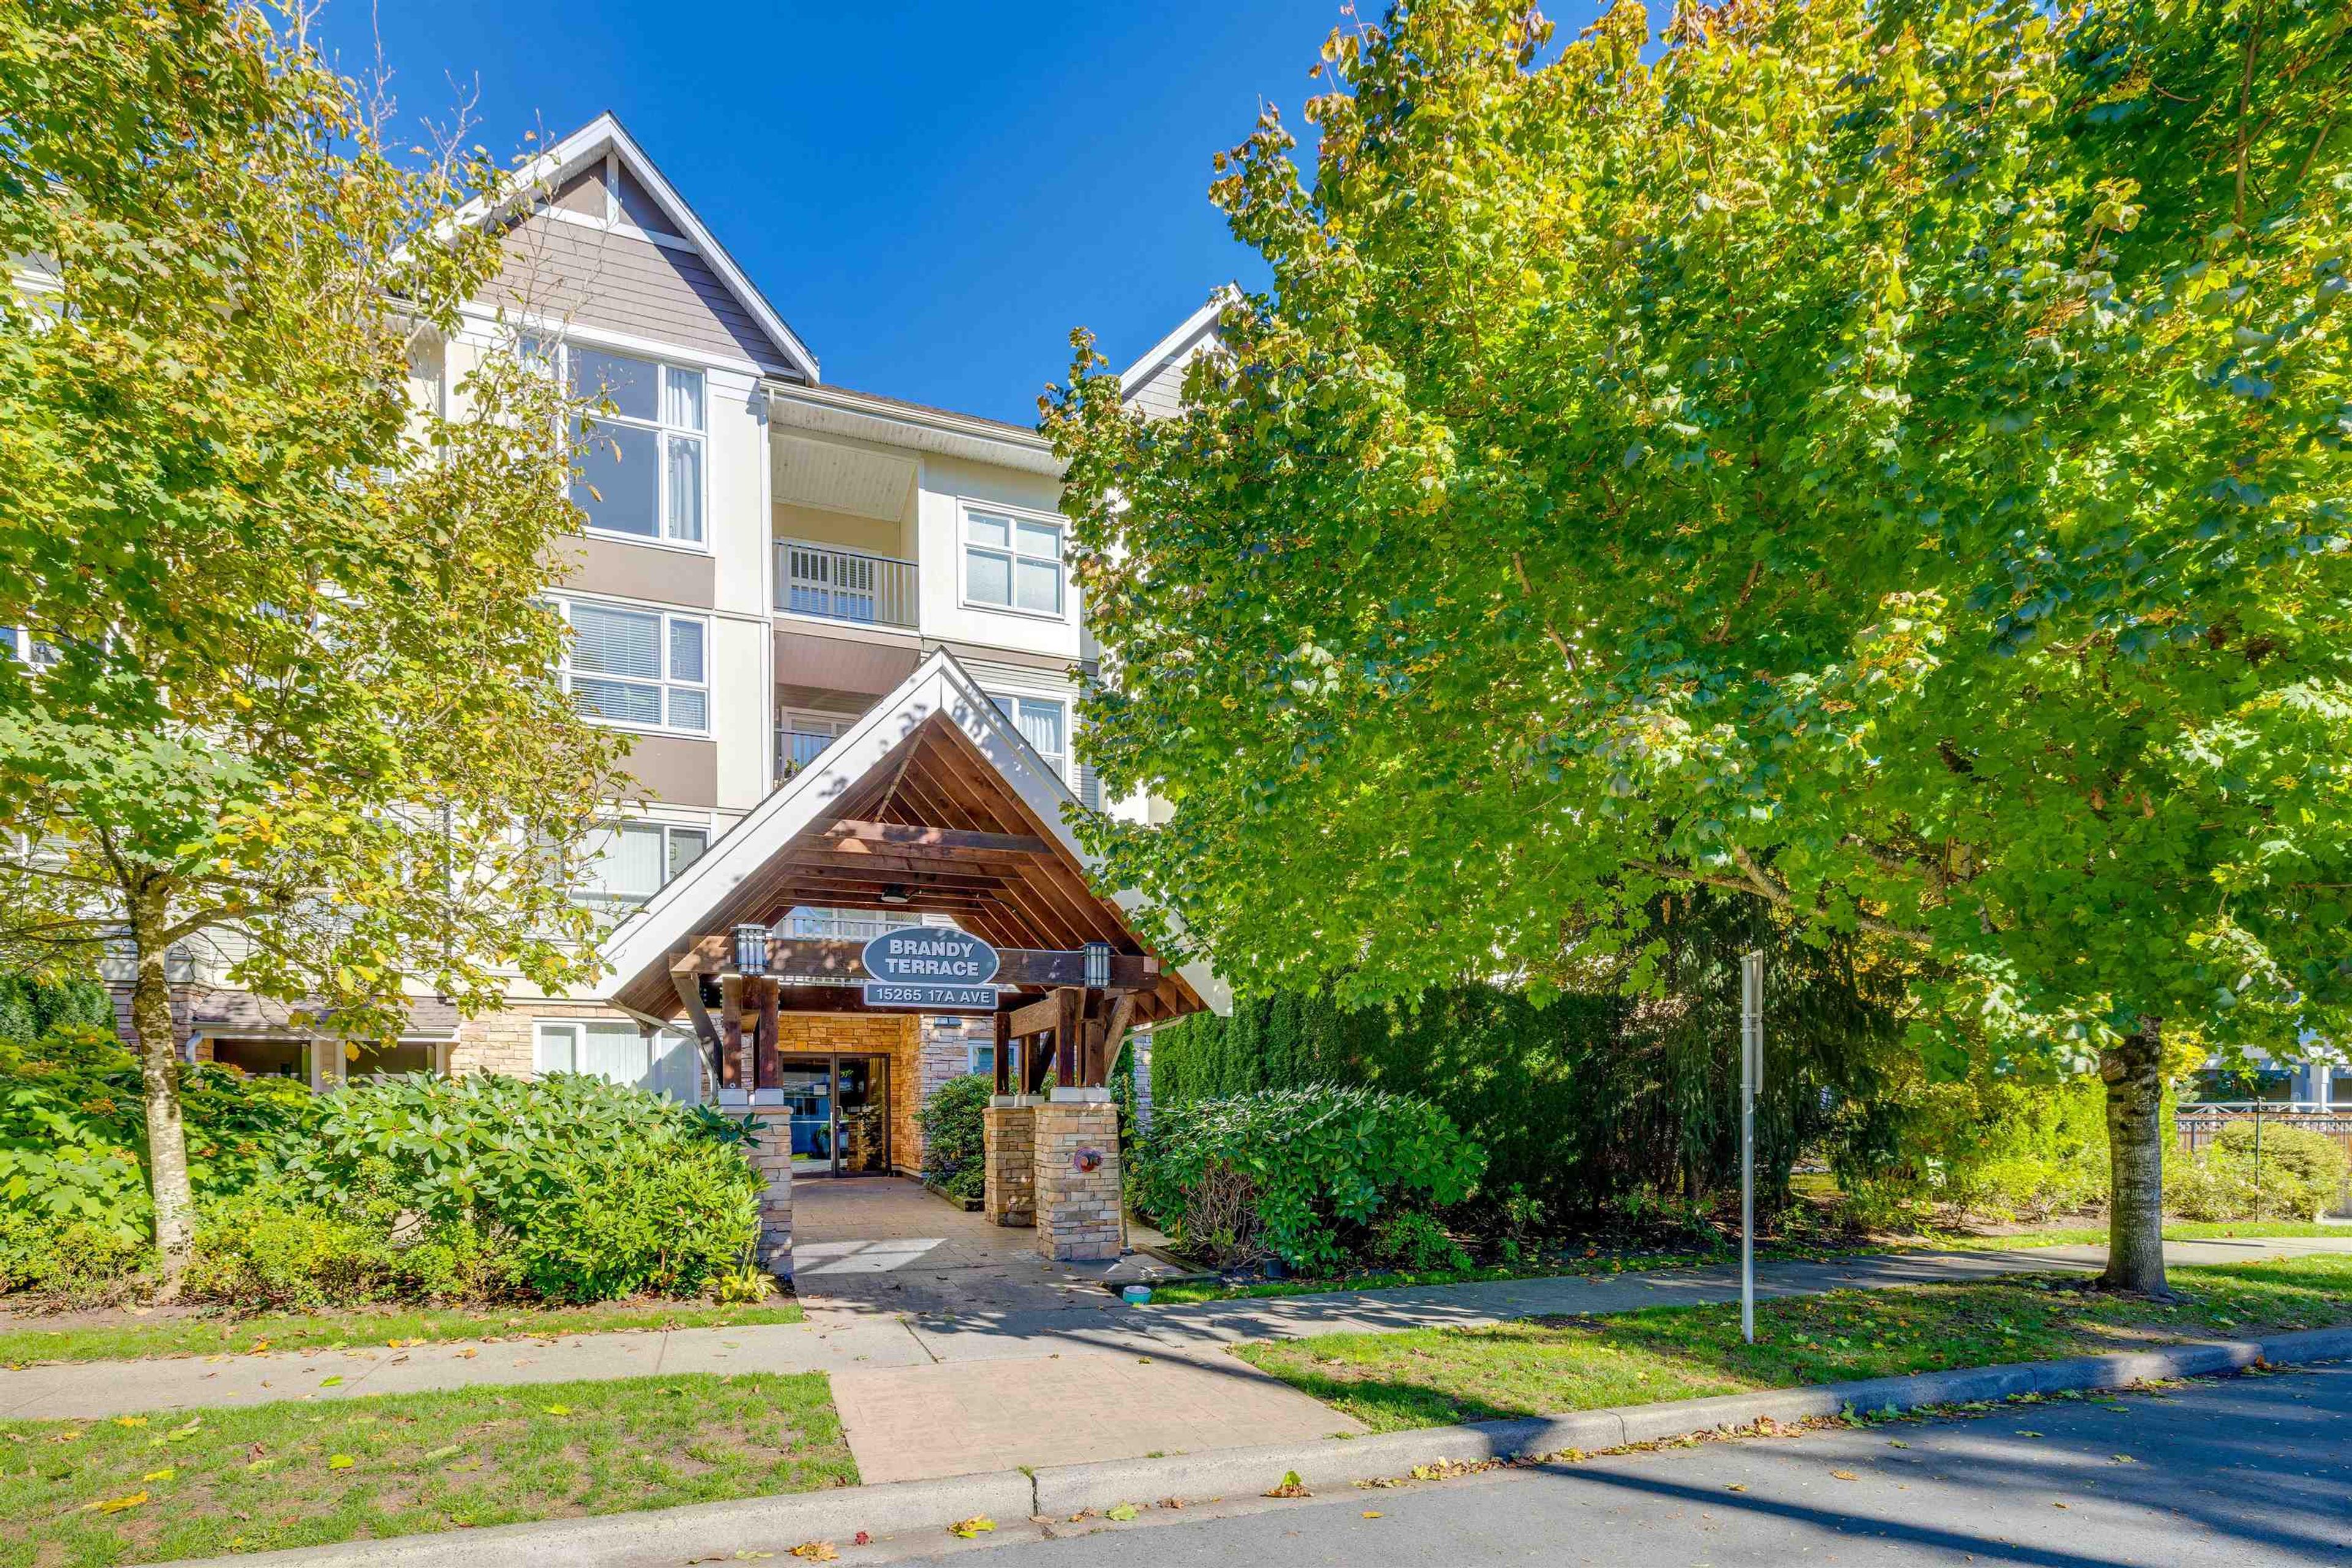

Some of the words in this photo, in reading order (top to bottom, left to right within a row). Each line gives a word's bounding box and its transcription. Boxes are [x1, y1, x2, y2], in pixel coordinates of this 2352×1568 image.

[889, 940, 974, 957] BRANDY
[885, 958, 979, 976] TERRACE
[876, 988, 922, 1001] 15265
[928, 990, 955, 1003] 17A
[960, 991, 990, 1003] AVE
